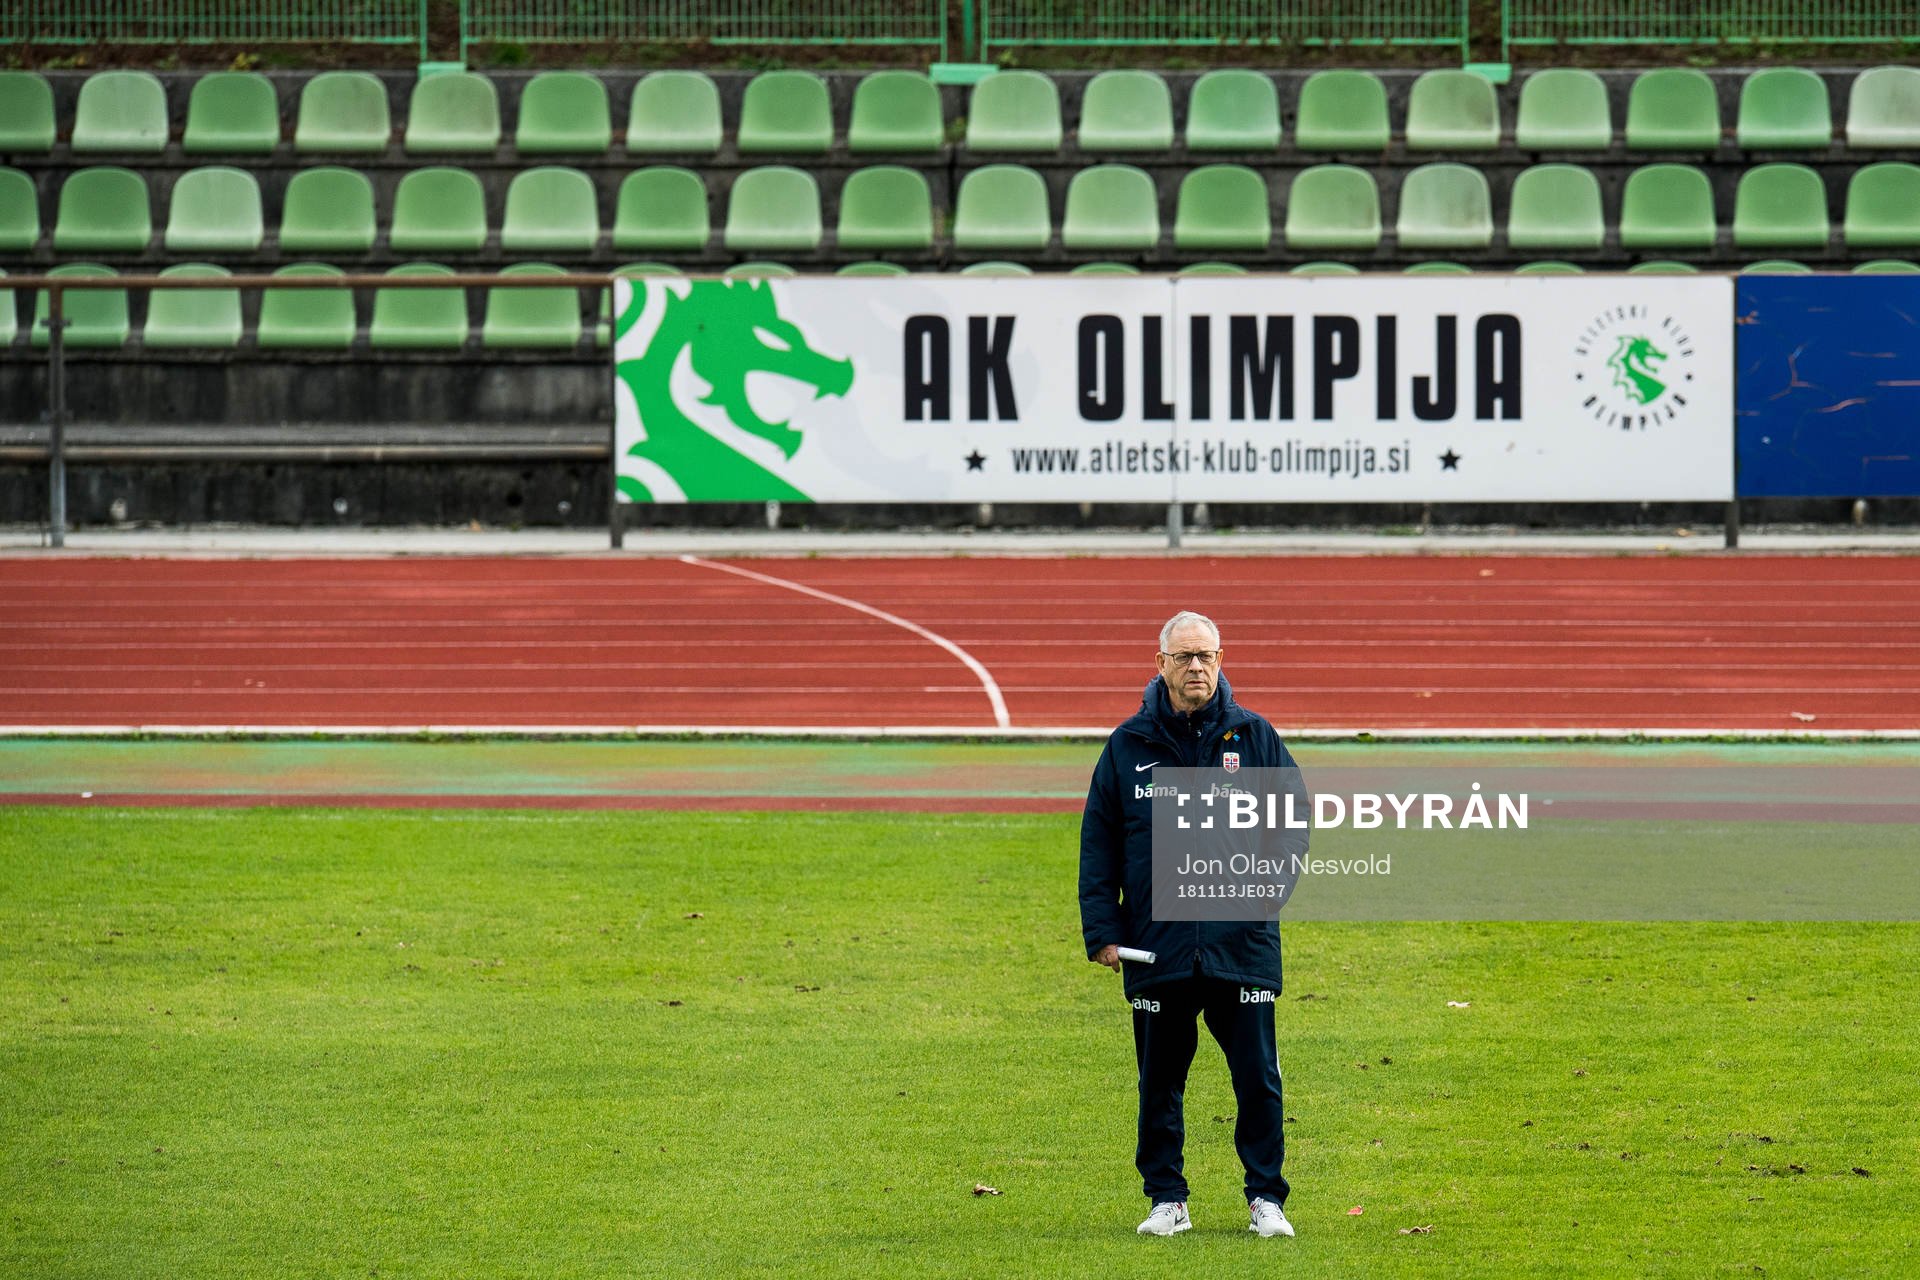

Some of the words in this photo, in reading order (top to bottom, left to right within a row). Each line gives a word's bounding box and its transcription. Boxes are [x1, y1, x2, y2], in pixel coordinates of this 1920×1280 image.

[904, 315, 1019, 421] AK
[1078, 314, 1523, 422] OLIMPIJA
[1583, 393, 1687, 431] OLIMPIJA
[1011, 440, 1411, 479] www.atletski-klub-olimpija.si
[1131, 994, 1161, 1013] ama
